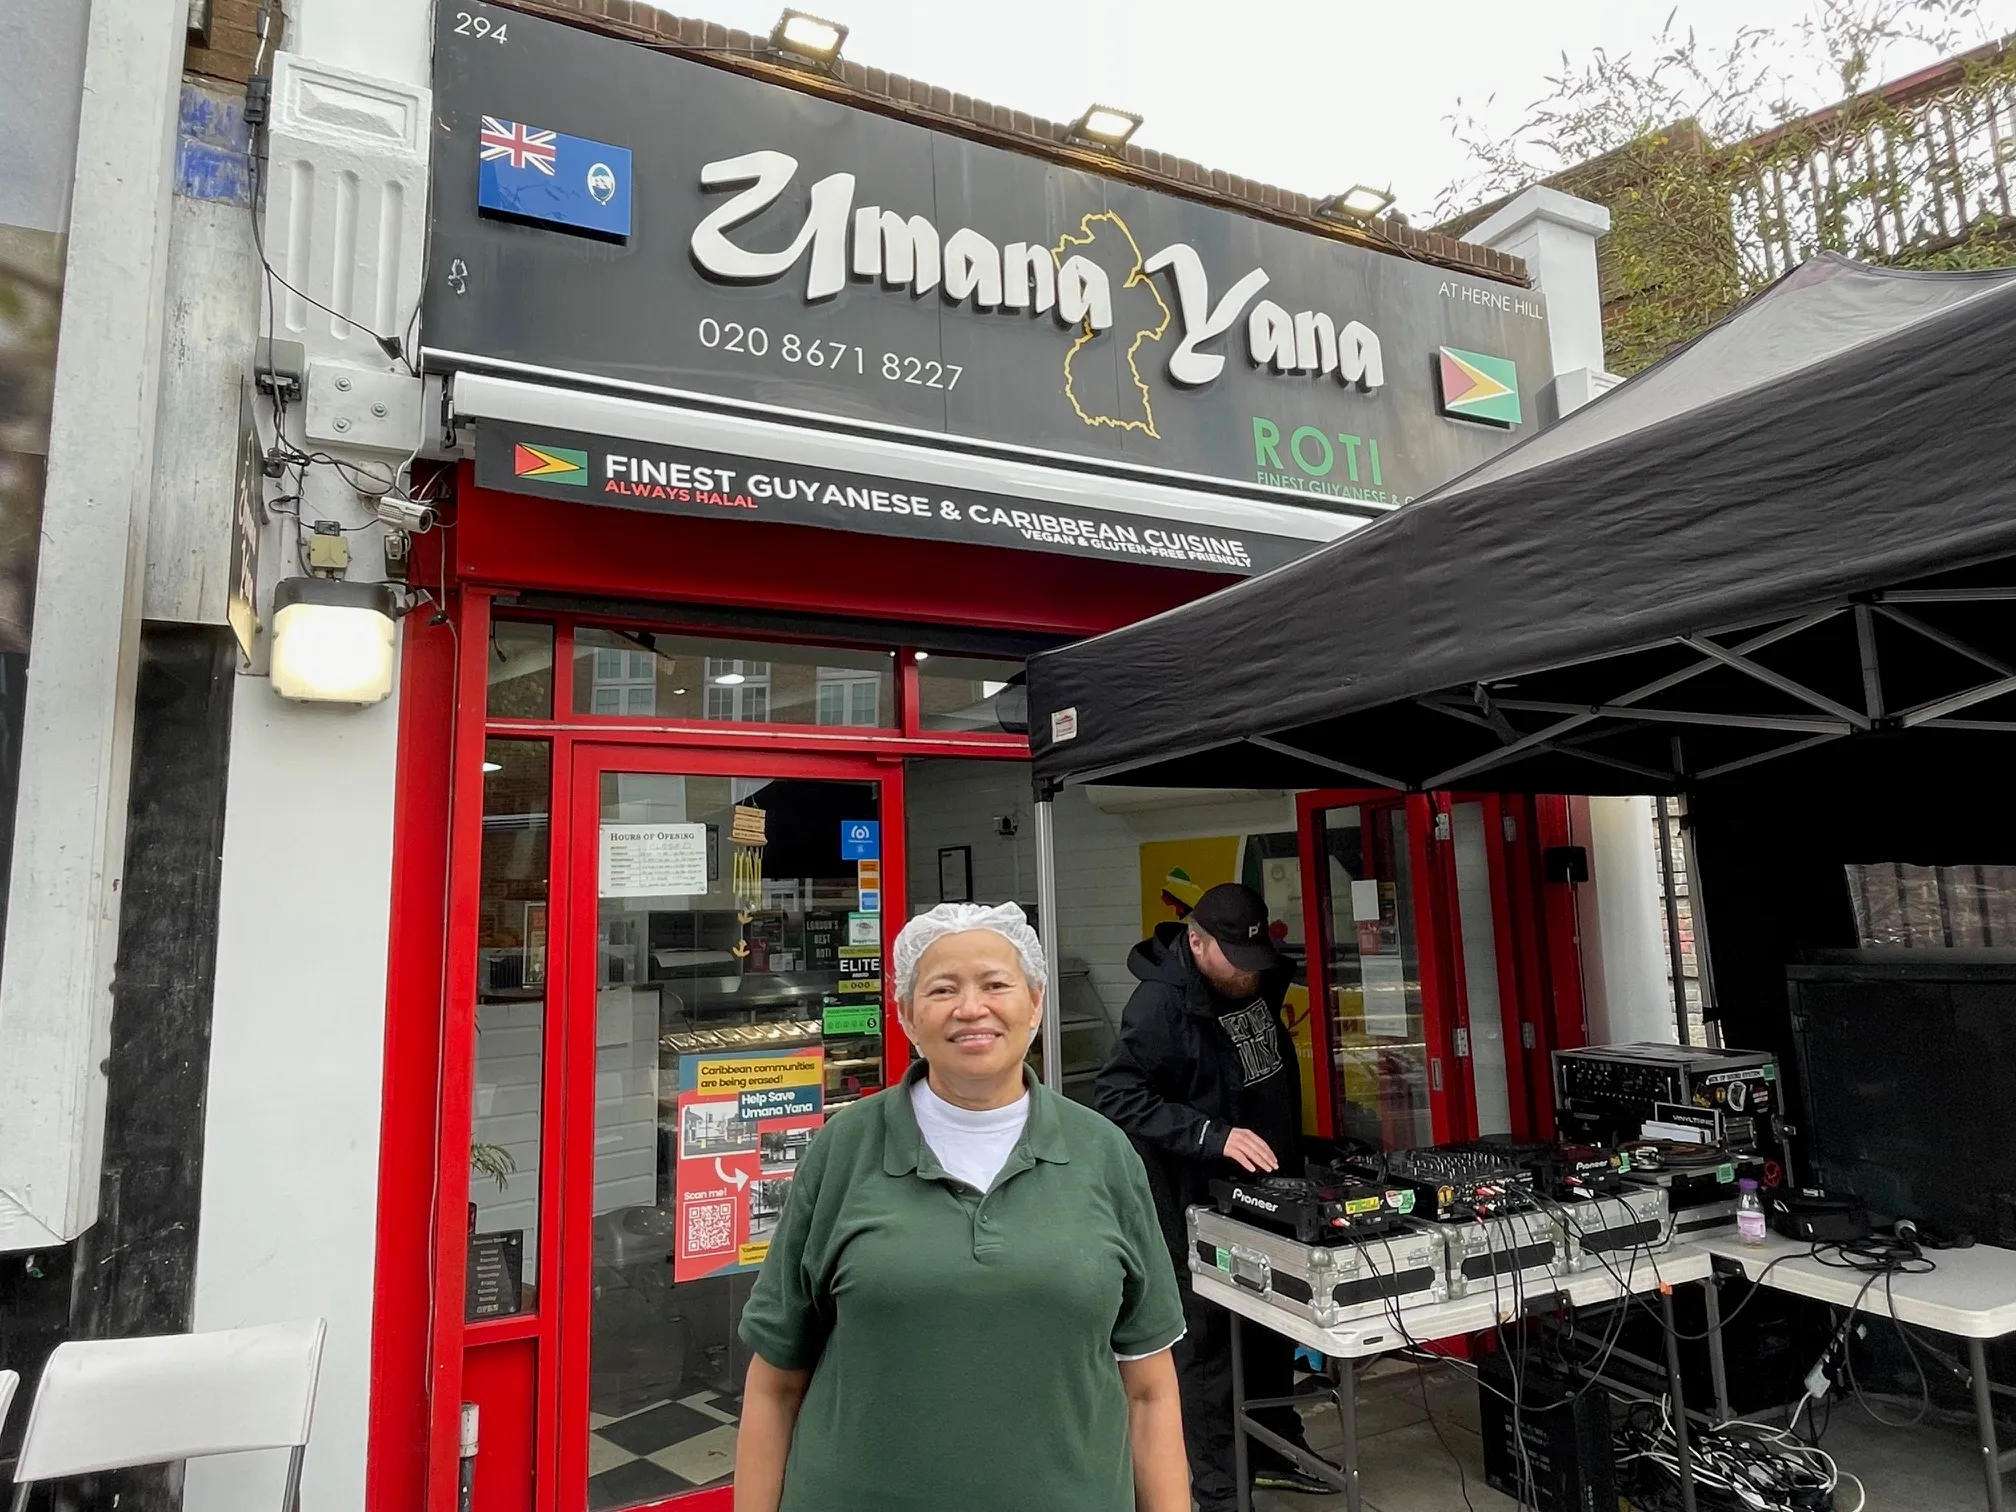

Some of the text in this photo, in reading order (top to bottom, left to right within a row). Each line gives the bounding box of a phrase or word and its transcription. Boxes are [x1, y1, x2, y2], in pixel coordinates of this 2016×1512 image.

[454, 12, 507, 44] 294
[691, 150, 1384, 388] Umana Yana
[1439, 281, 1542, 319] AT HERNE HILL
[699, 318, 963, 390] 020 8671 8227
[1253, 416, 1382, 485] ROTI
[1257, 471, 1304, 490] FINEST
[605, 480, 758, 508] ALWAYS HALAL
[606, 454, 1248, 558] FINEST GUYANESE & CARIBBEAN CUISINE
[1020, 529, 1251, 567] VEGAN & GLUTEN-FREE FRIENDLY
[840, 959, 880, 972] ELITE
[701, 1061, 815, 1075] Caribbean communities
[701, 1075, 783, 1088] are being erased!
[741, 1091, 795, 1106] Help Save
[741, 1102, 813, 1118] Umana Yana
[684, 1187, 727, 1200] Scan me!
[1232, 1188, 1278, 1212] Pioneer
